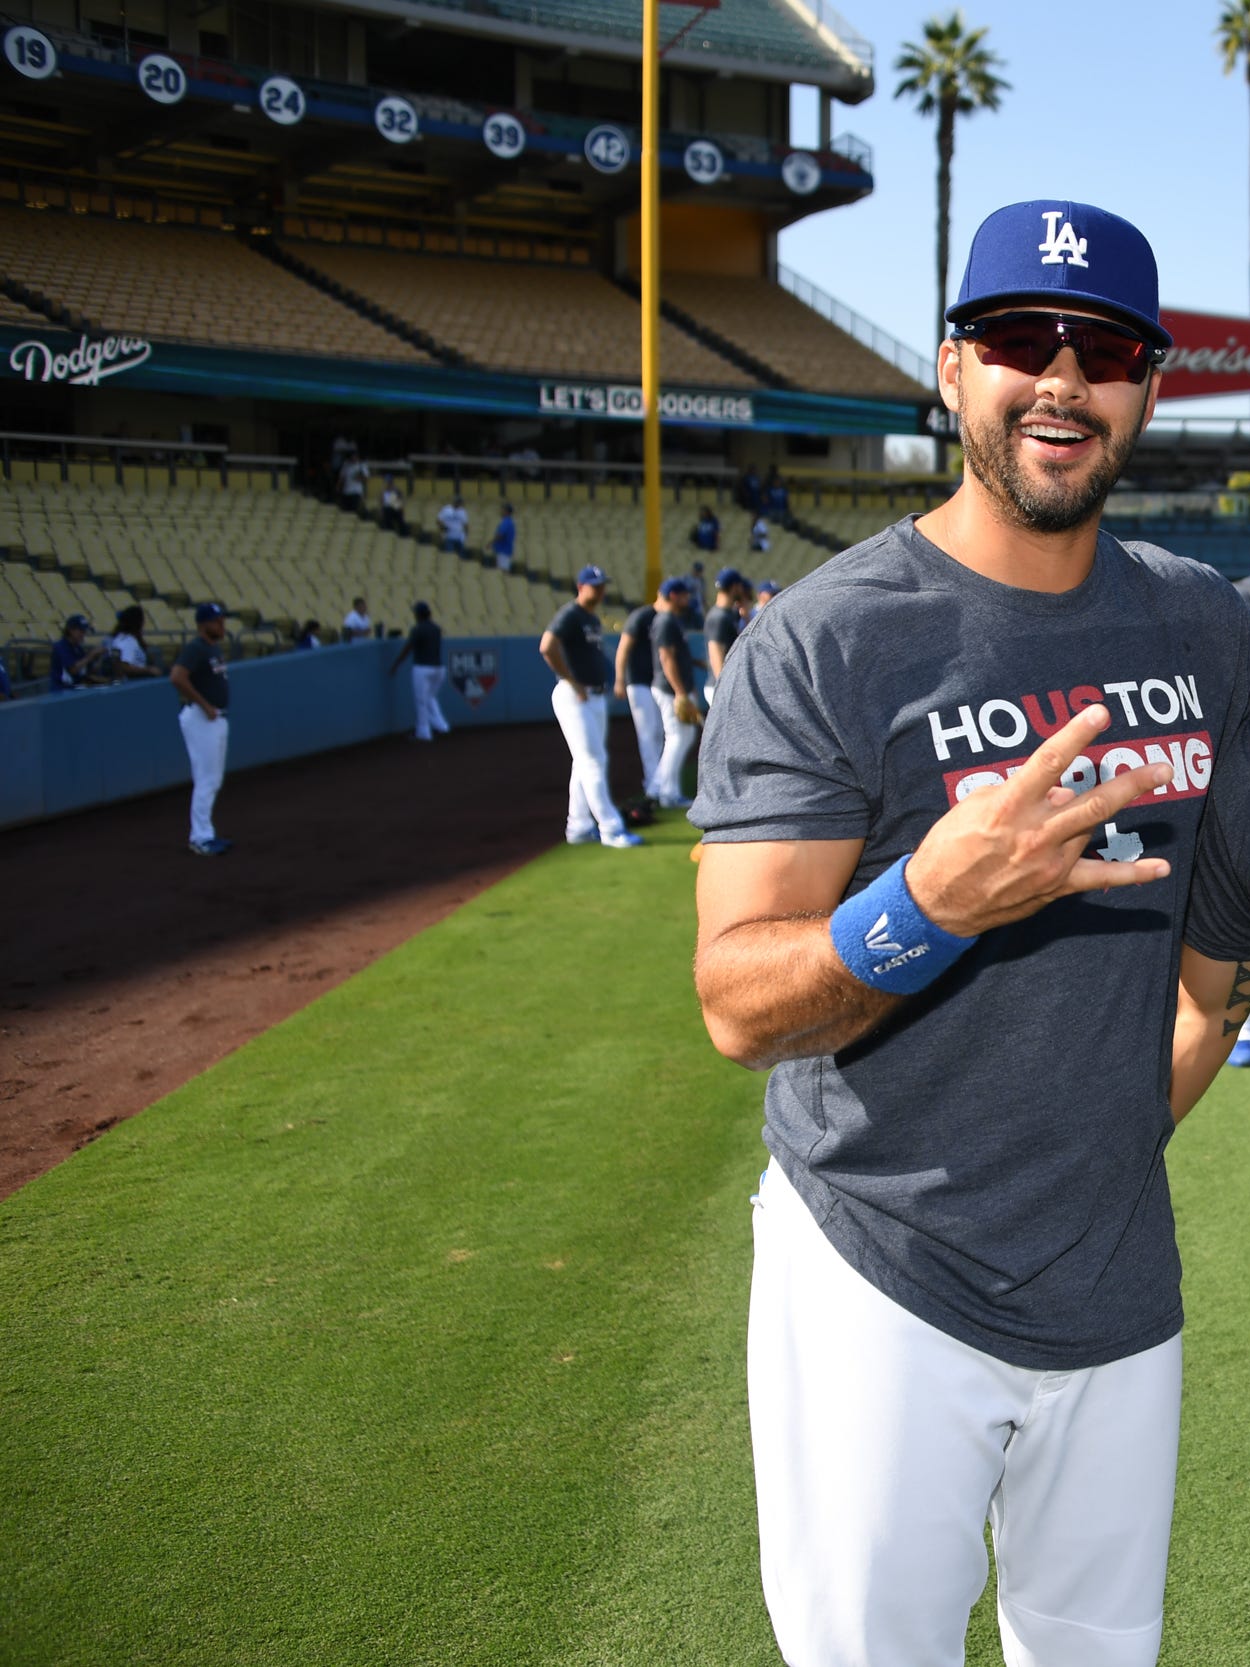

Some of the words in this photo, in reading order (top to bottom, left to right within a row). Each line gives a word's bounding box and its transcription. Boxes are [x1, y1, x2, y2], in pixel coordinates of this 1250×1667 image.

[15, 36, 47, 69] 19
[145, 64, 180, 94] 20
[265, 87, 302, 115] 24
[382, 107, 412, 133] 32
[490, 123, 519, 148] 39
[592, 136, 625, 163] 42
[690, 150, 717, 174] 53
[1039, 211, 1088, 268] LA
[540, 385, 605, 411] LET'S
[610, 388, 642, 414] GO
[656, 392, 752, 419] ODGERS
[873, 943, 931, 974] EASTON
